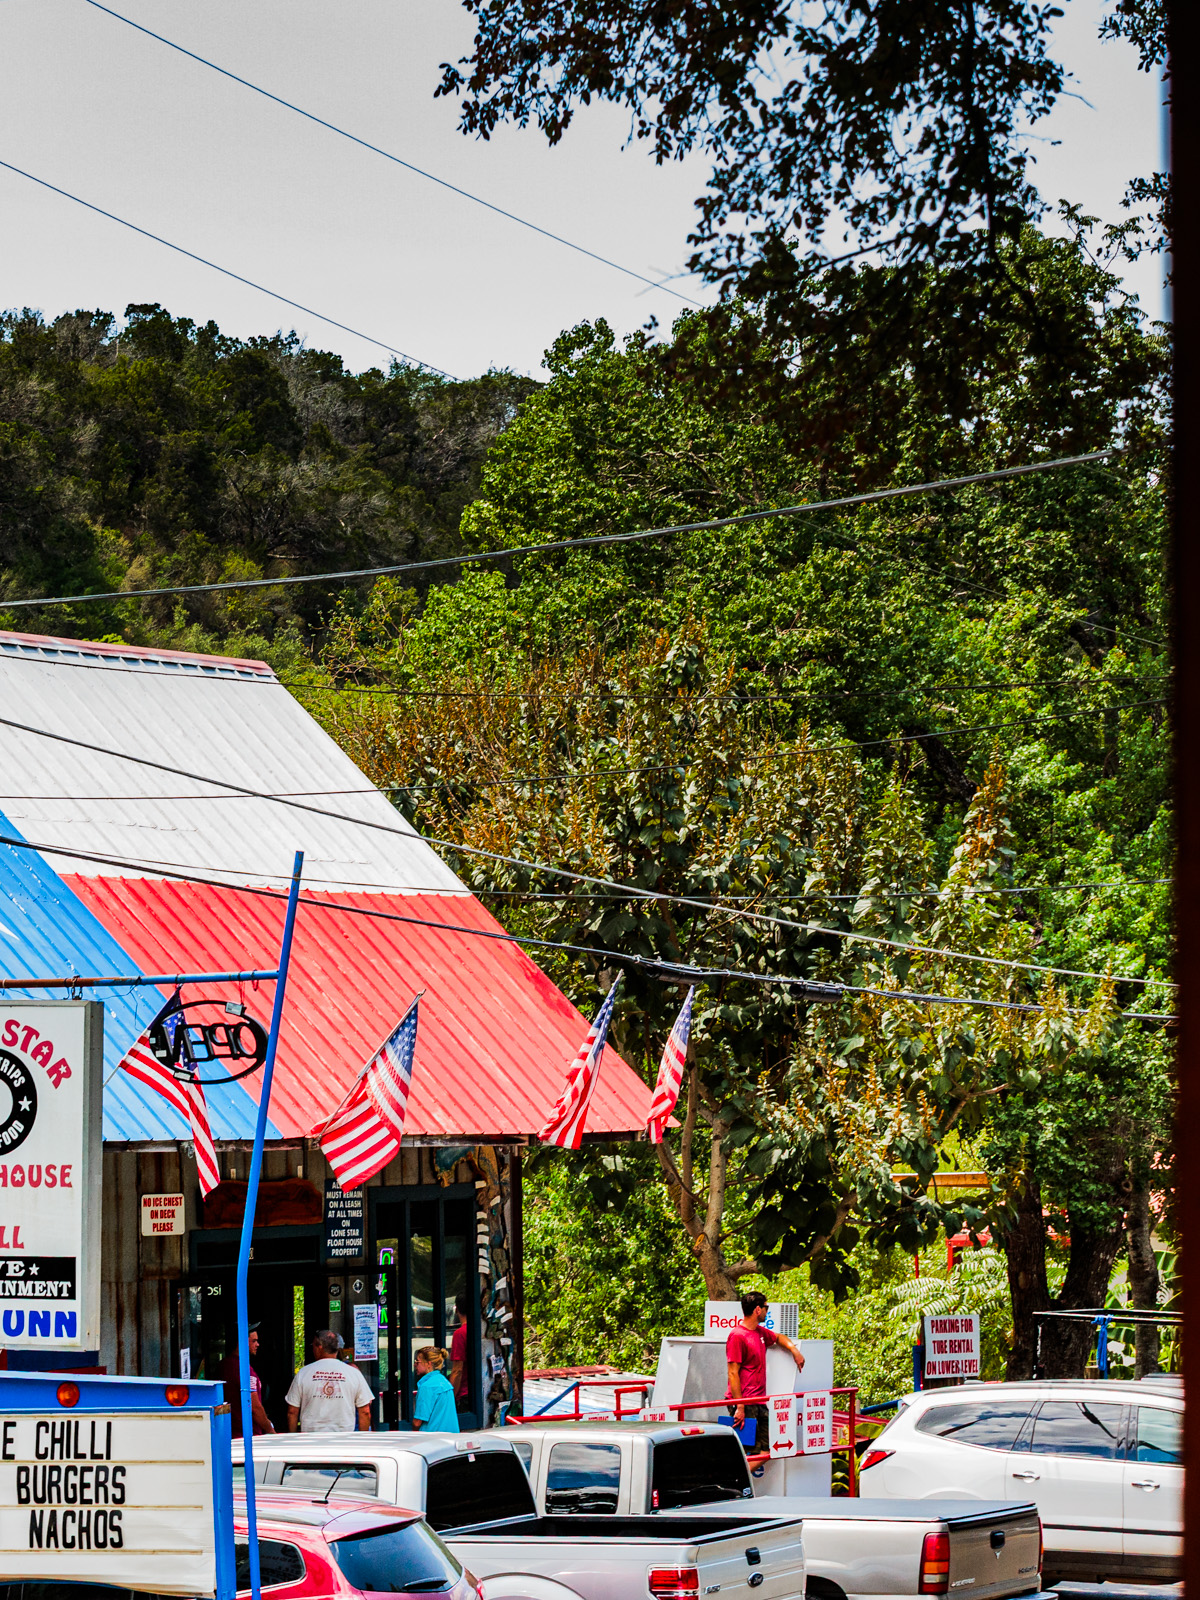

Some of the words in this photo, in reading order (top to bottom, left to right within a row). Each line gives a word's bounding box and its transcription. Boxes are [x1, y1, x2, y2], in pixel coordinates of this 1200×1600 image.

[1, 1018, 73, 1089] STAR
[326, 1191, 342, 1199] MUST
[343, 1190, 362, 1198] REMAIN
[143, 1198, 151, 1207] NO
[153, 1197, 162, 1207] ICE
[164, 1196, 182, 1206] CHEST
[345, 1200, 361, 1208] LEASH
[150, 1210, 158, 1219] ON
[160, 1209, 175, 1219] DECK
[337, 1210, 346, 1218] ALL
[152, 1222, 173, 1232] PLEASE
[345, 1238, 362, 1246] HOUSE
[332, 1248, 358, 1256] PROPERTY
[931, 1319, 960, 1334] PARKING
[961, 1318, 973, 1333] FOR
[932, 1340, 948, 1354] TUBE
[949, 1339, 973, 1353] RENTAL
[926, 1361, 936, 1375] ON
[938, 1360, 960, 1375] LOWER
[961, 1359, 978, 1373] LEVEL
[35, 1420, 112, 1461] CHILLI
[17, 1464, 127, 1506] BURGERS
[29, 1509, 124, 1550] NACHOS
